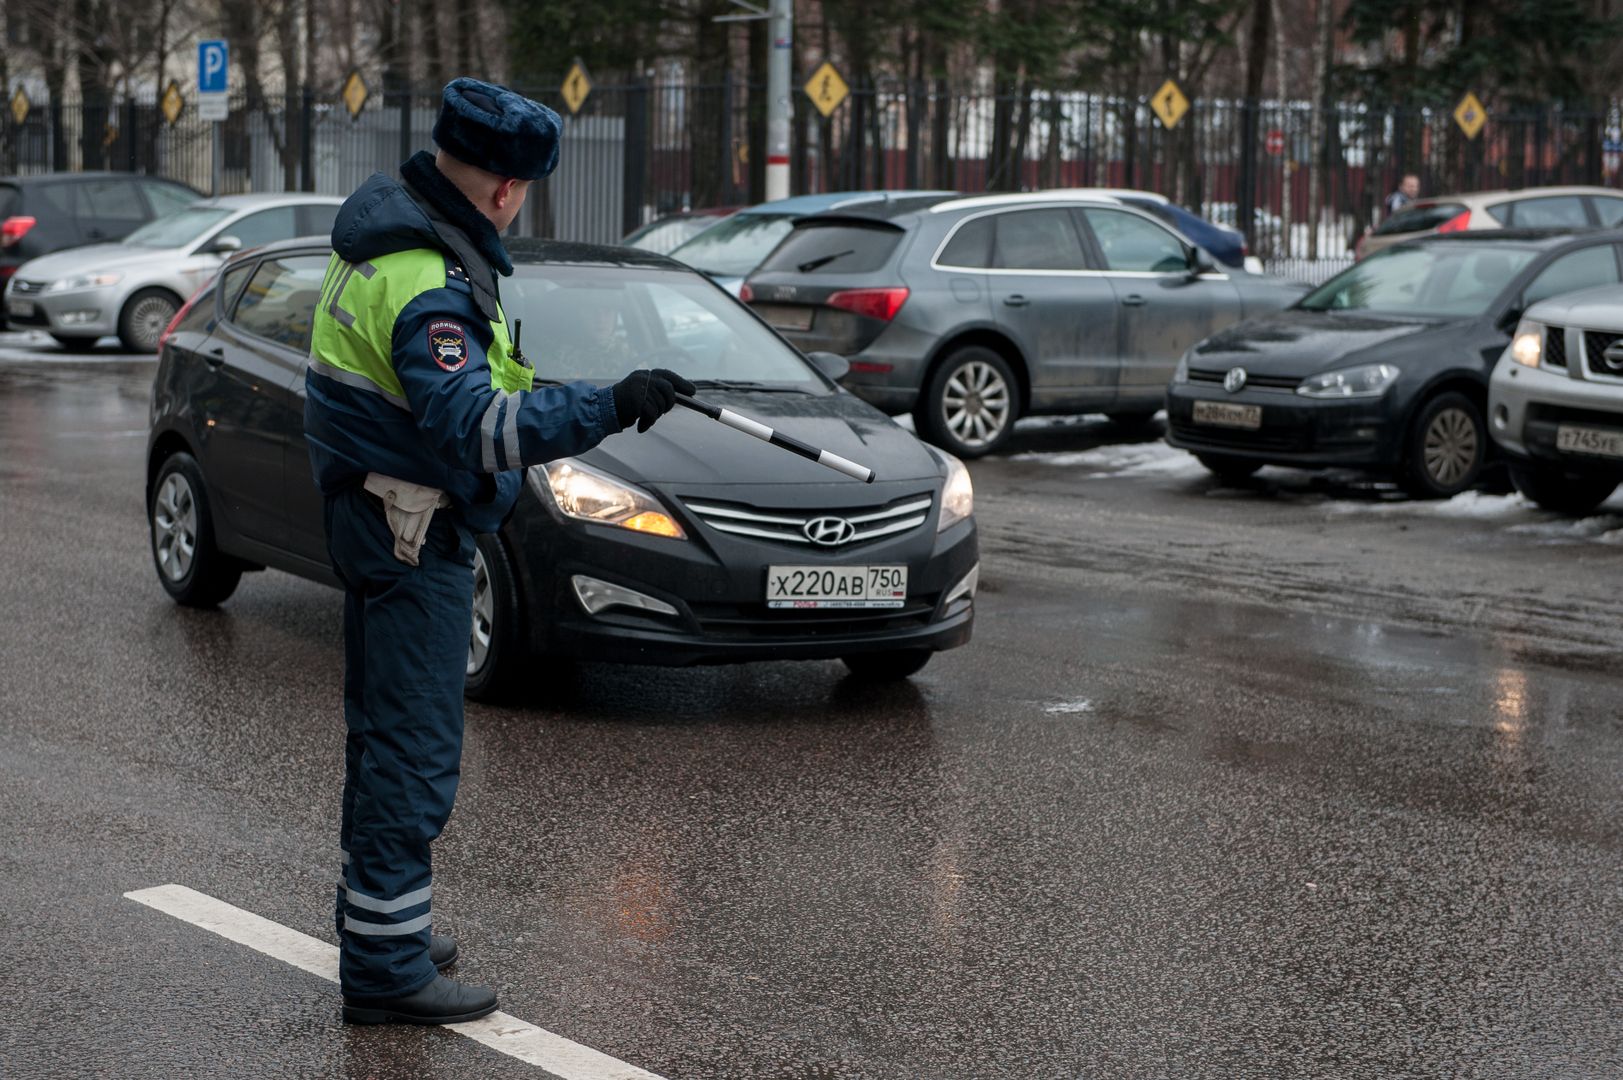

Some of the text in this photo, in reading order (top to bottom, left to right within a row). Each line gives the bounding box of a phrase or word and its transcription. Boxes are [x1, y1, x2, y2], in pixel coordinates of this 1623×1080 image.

[205, 46, 223, 87] P
[431, 322, 462, 333] ПОЛИЦИЯ
[776, 569, 901, 596] Х220АВ 750
[876, 588, 892, 596] RUS
